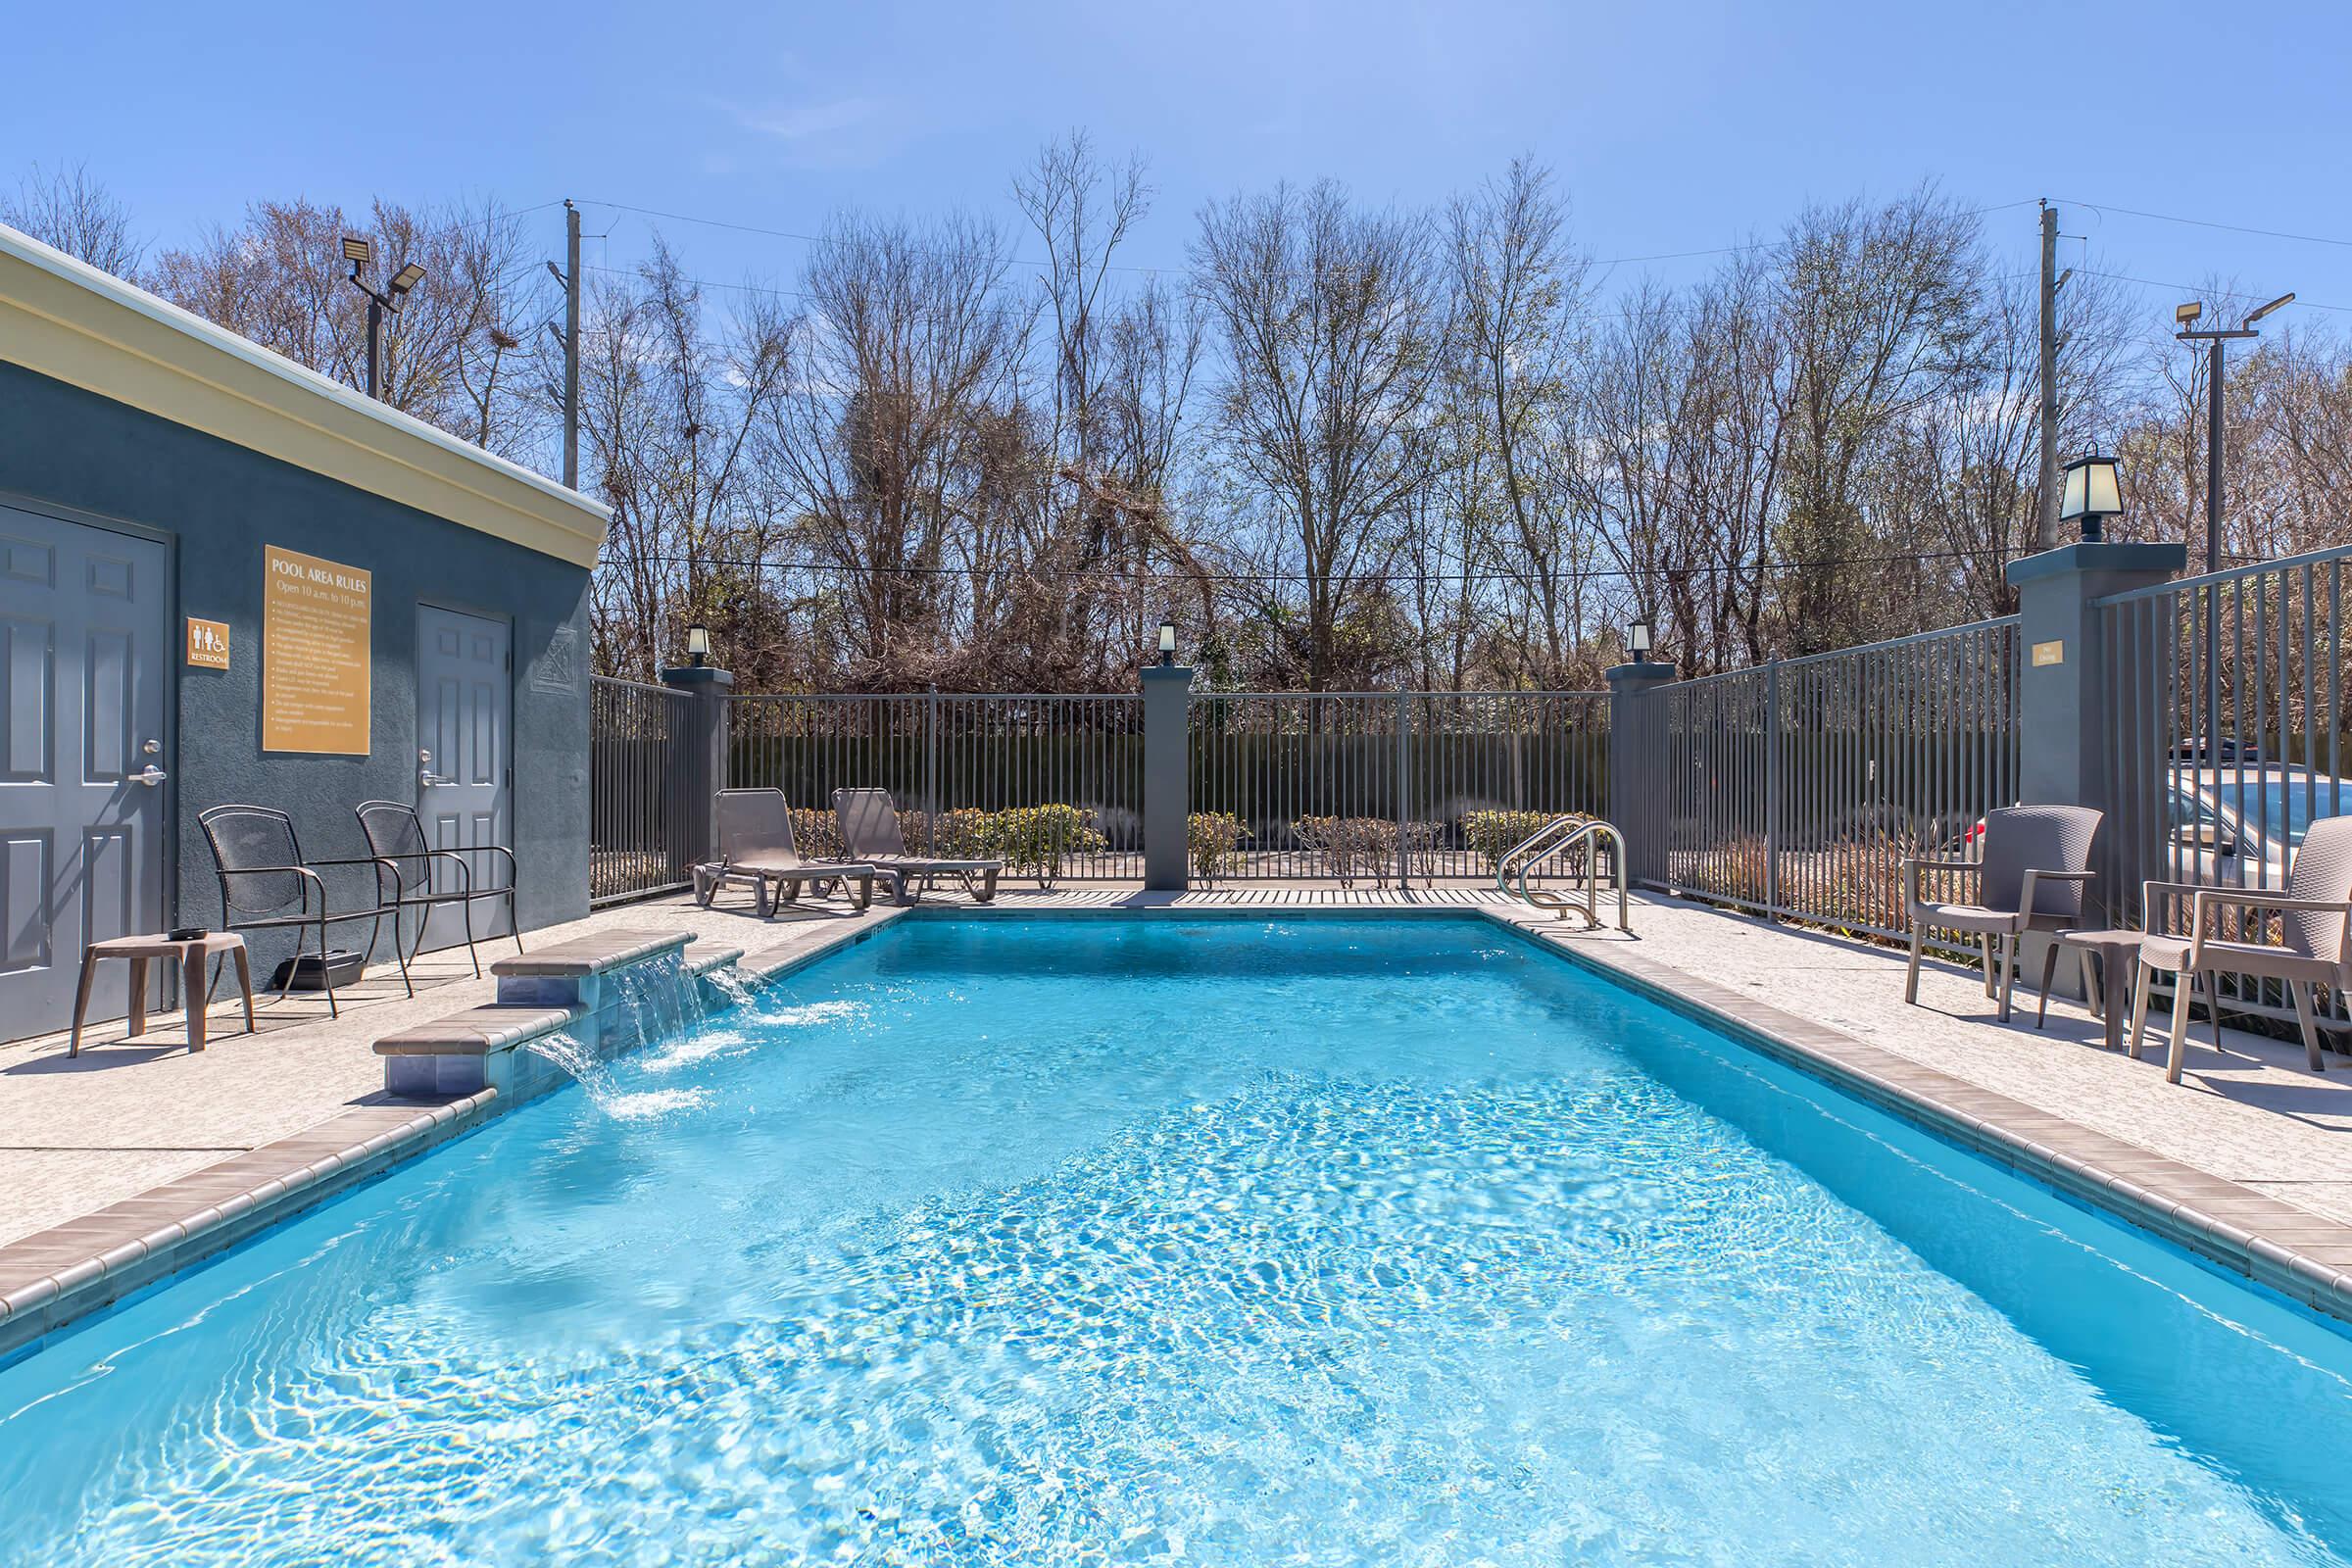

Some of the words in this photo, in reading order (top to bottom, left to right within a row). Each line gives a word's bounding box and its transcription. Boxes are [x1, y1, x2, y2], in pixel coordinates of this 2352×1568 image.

[272, 559, 305, 579] POOL
[307, 567, 334, 585] AREA
[336, 574, 367, 593] RULES
[276, 580, 299, 594] Open
[302, 586, 312, 597] 10
[314, 590, 329, 601] a.m.
[331, 593, 339, 604] to
[341, 595, 350, 605] 10
[192, 653, 226, 663] RESTROOM
